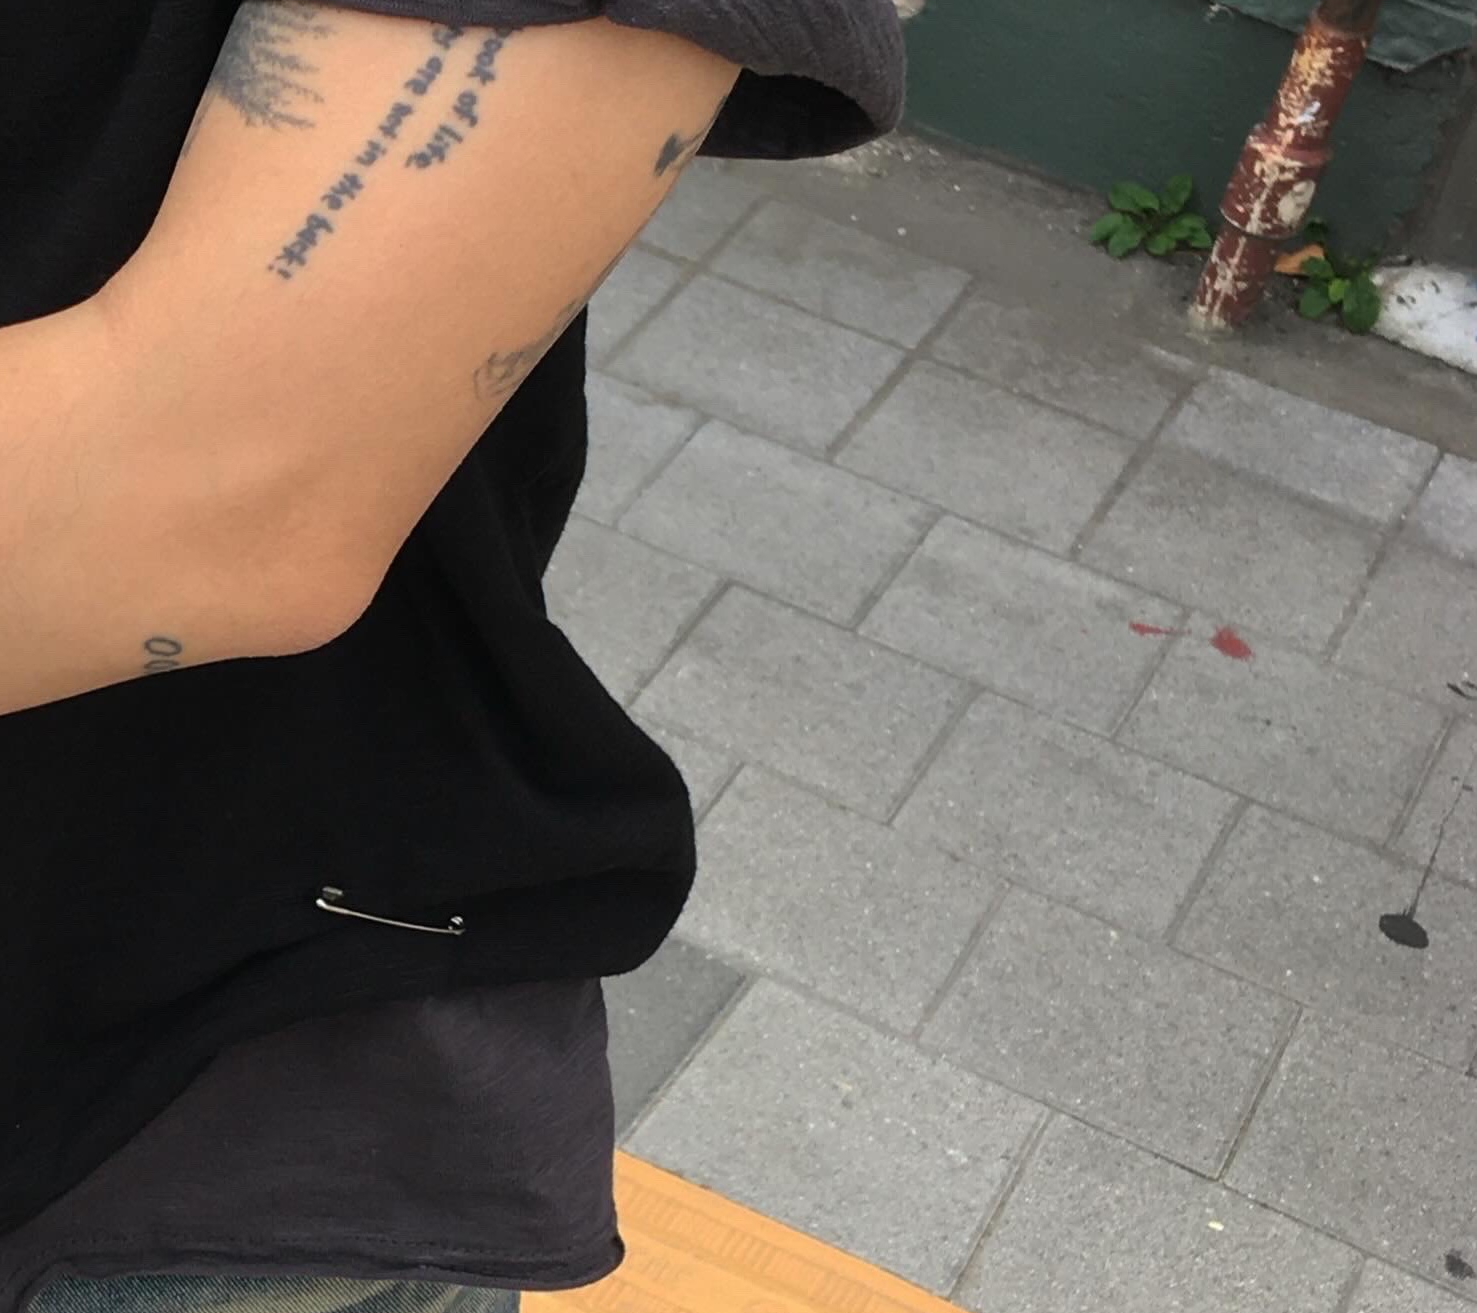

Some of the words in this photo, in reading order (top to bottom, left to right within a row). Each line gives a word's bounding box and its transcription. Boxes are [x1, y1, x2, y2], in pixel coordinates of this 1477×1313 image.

[403, 56, 443, 96] are
[452, 90, 478, 128] of
[355, 140, 387, 167] in
[320, 173, 364, 211] the
[267, 213, 334, 280] back!
